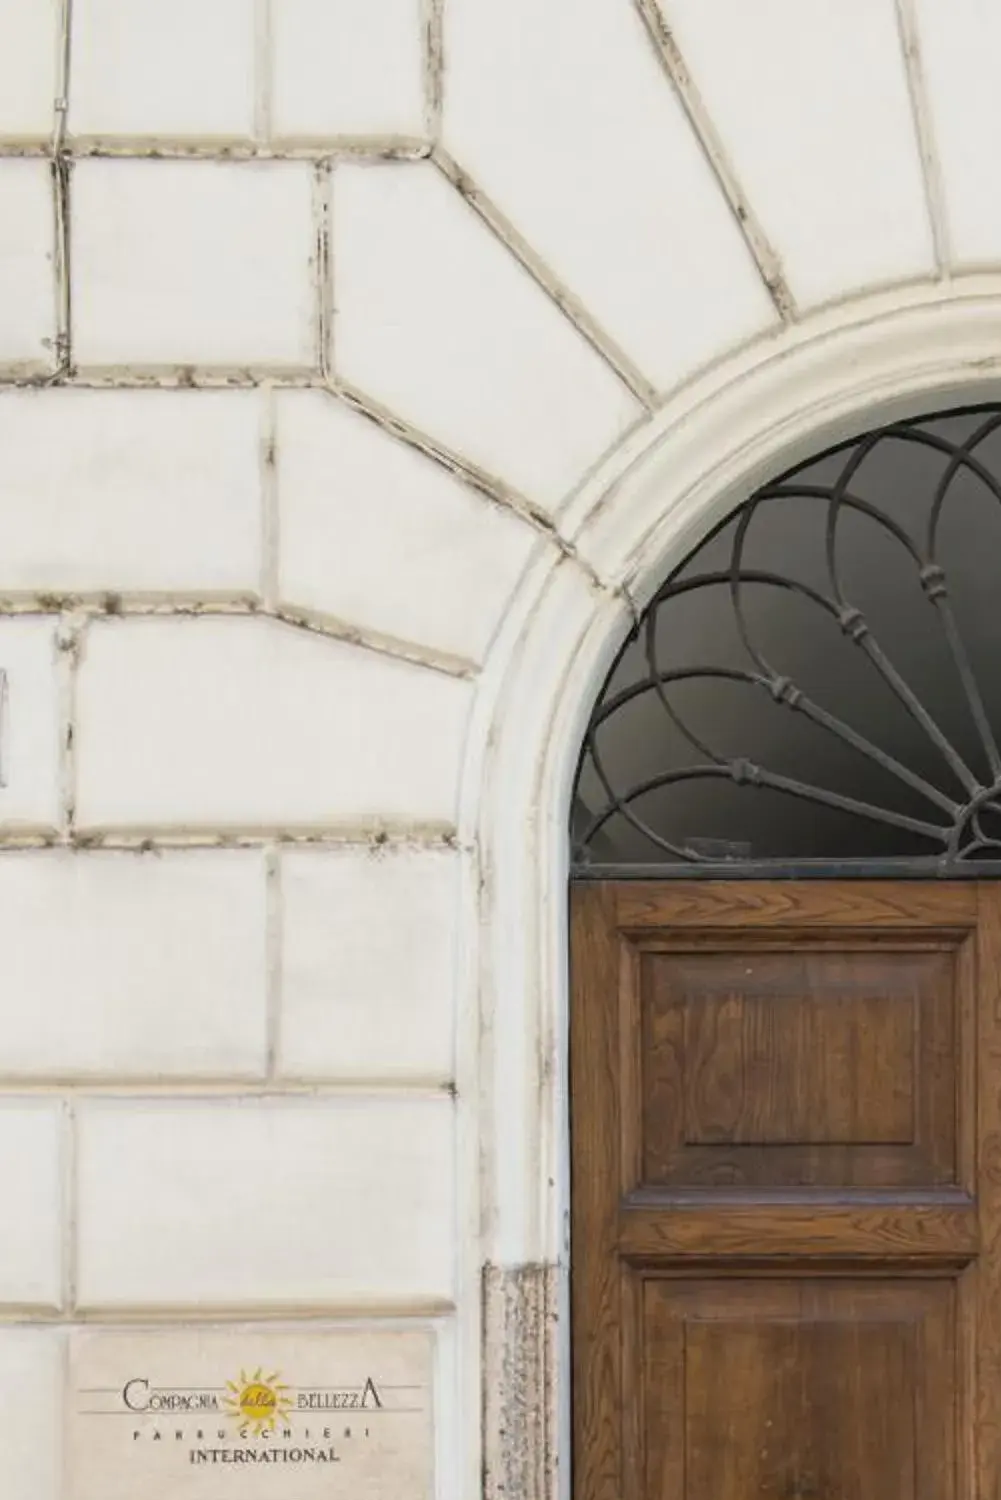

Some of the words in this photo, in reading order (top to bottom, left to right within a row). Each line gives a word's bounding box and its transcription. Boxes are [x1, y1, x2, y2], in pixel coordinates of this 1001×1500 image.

[297, 1376, 383, 1409] BELLEZZA
[132, 1427, 370, 1440] PARRUCCHIERI
[190, 1448, 340, 1464] INTERNATIONAL
